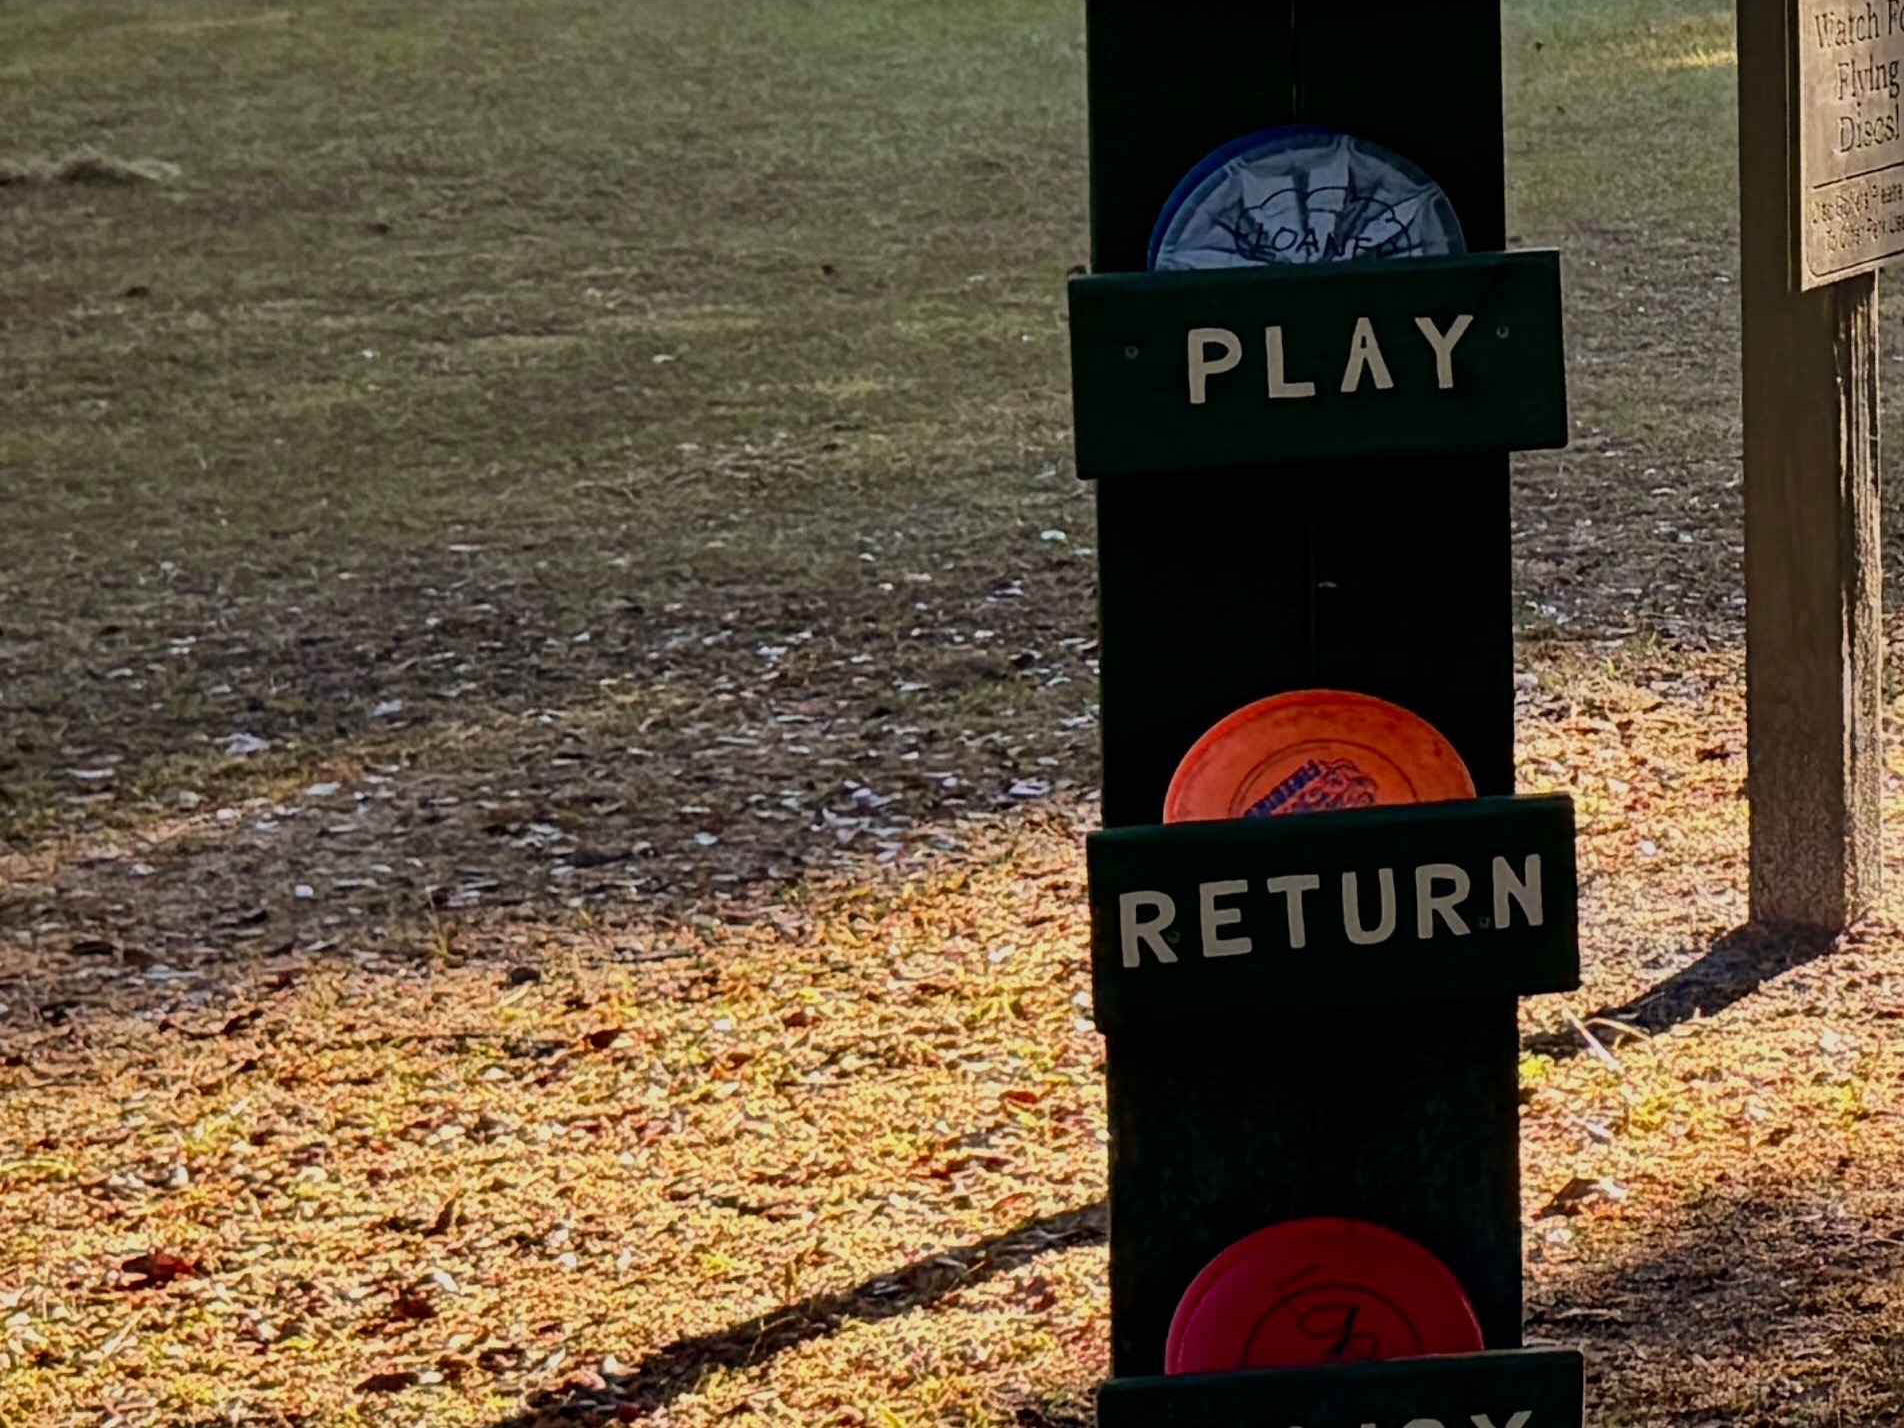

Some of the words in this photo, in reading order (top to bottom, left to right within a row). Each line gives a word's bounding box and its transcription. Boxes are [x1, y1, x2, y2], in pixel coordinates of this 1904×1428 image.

[1815, 2, 1880, 49] Watch
[1837, 53, 1901, 101] Flying
[1839, 102, 1901, 153] Discs!
[1187, 314, 1474, 405] PLAY
[1119, 854, 1544, 968] RETURN
